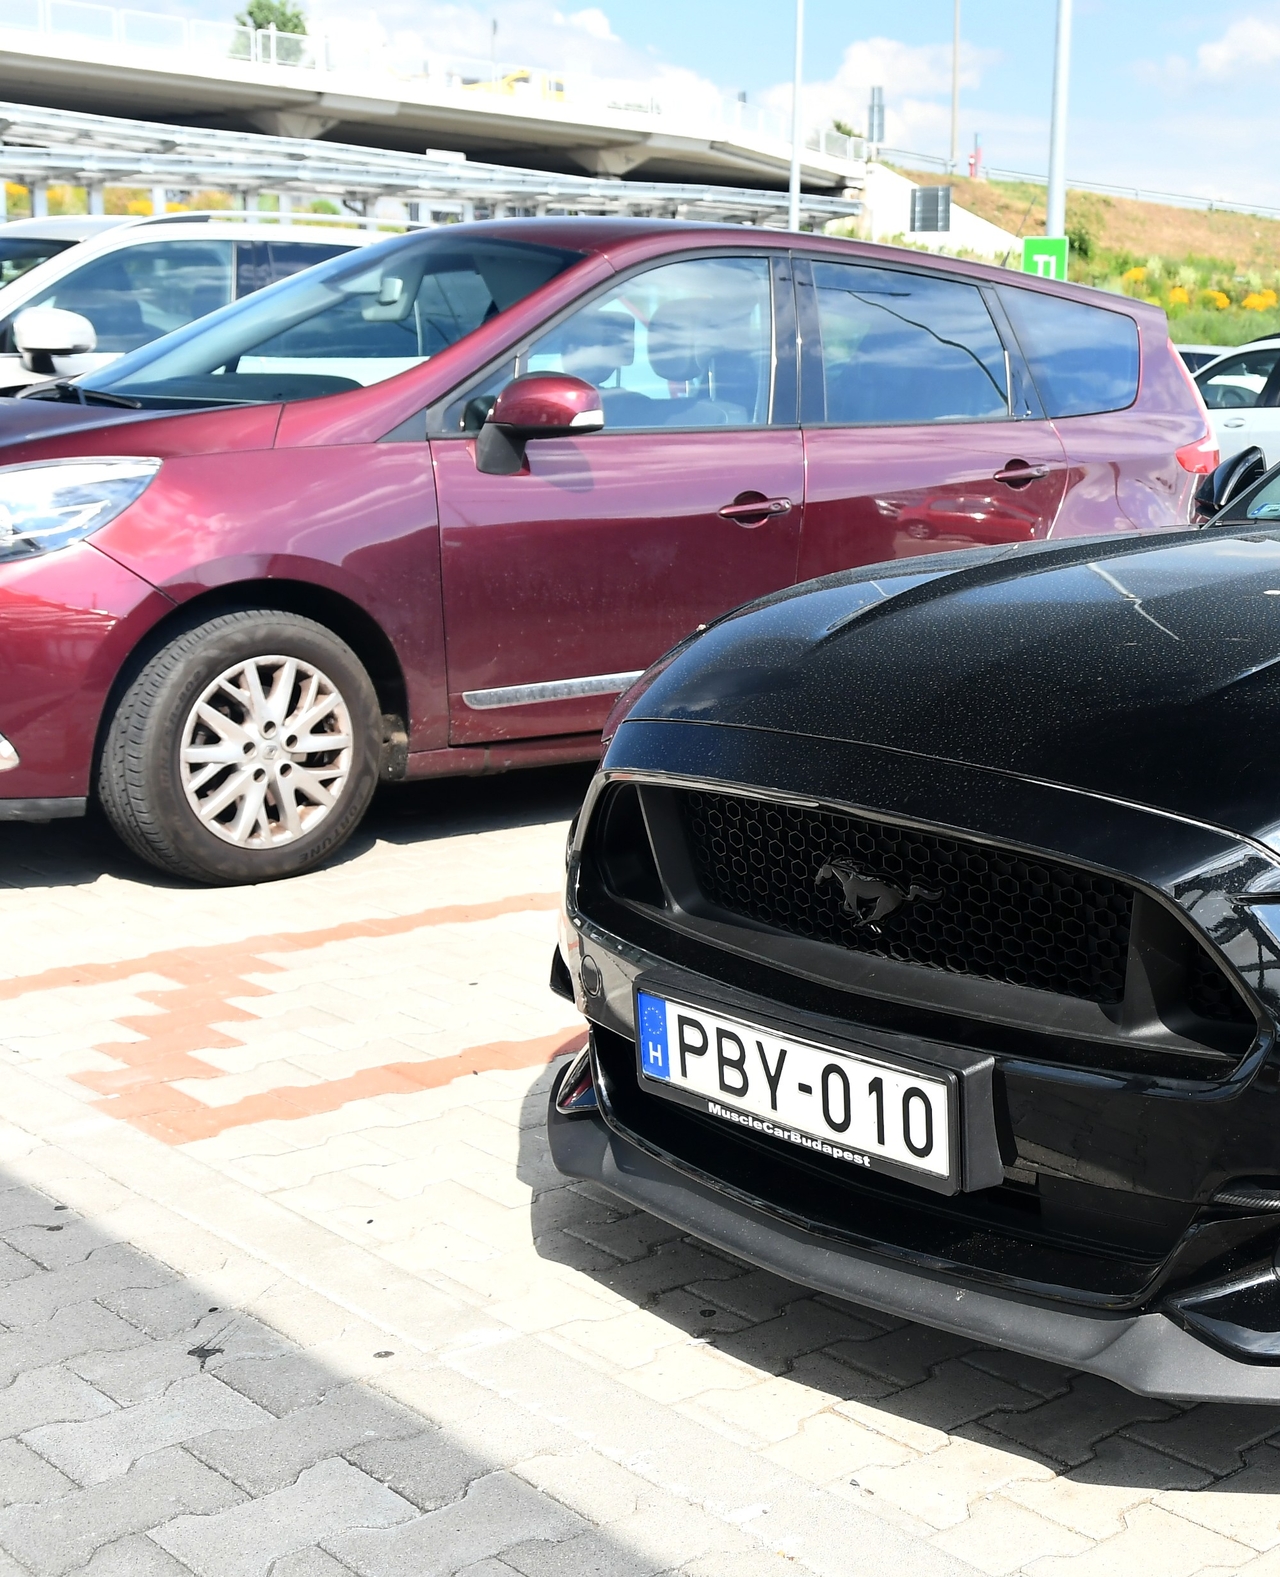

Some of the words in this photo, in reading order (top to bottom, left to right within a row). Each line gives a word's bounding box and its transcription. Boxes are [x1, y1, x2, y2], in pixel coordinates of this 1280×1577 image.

[1032, 254, 1057, 280] T1
[648, 1041, 664, 1068] H
[677, 1013, 934, 1158] PBY-010
[708, 1101, 871, 1168] MuscleCarBudapest
